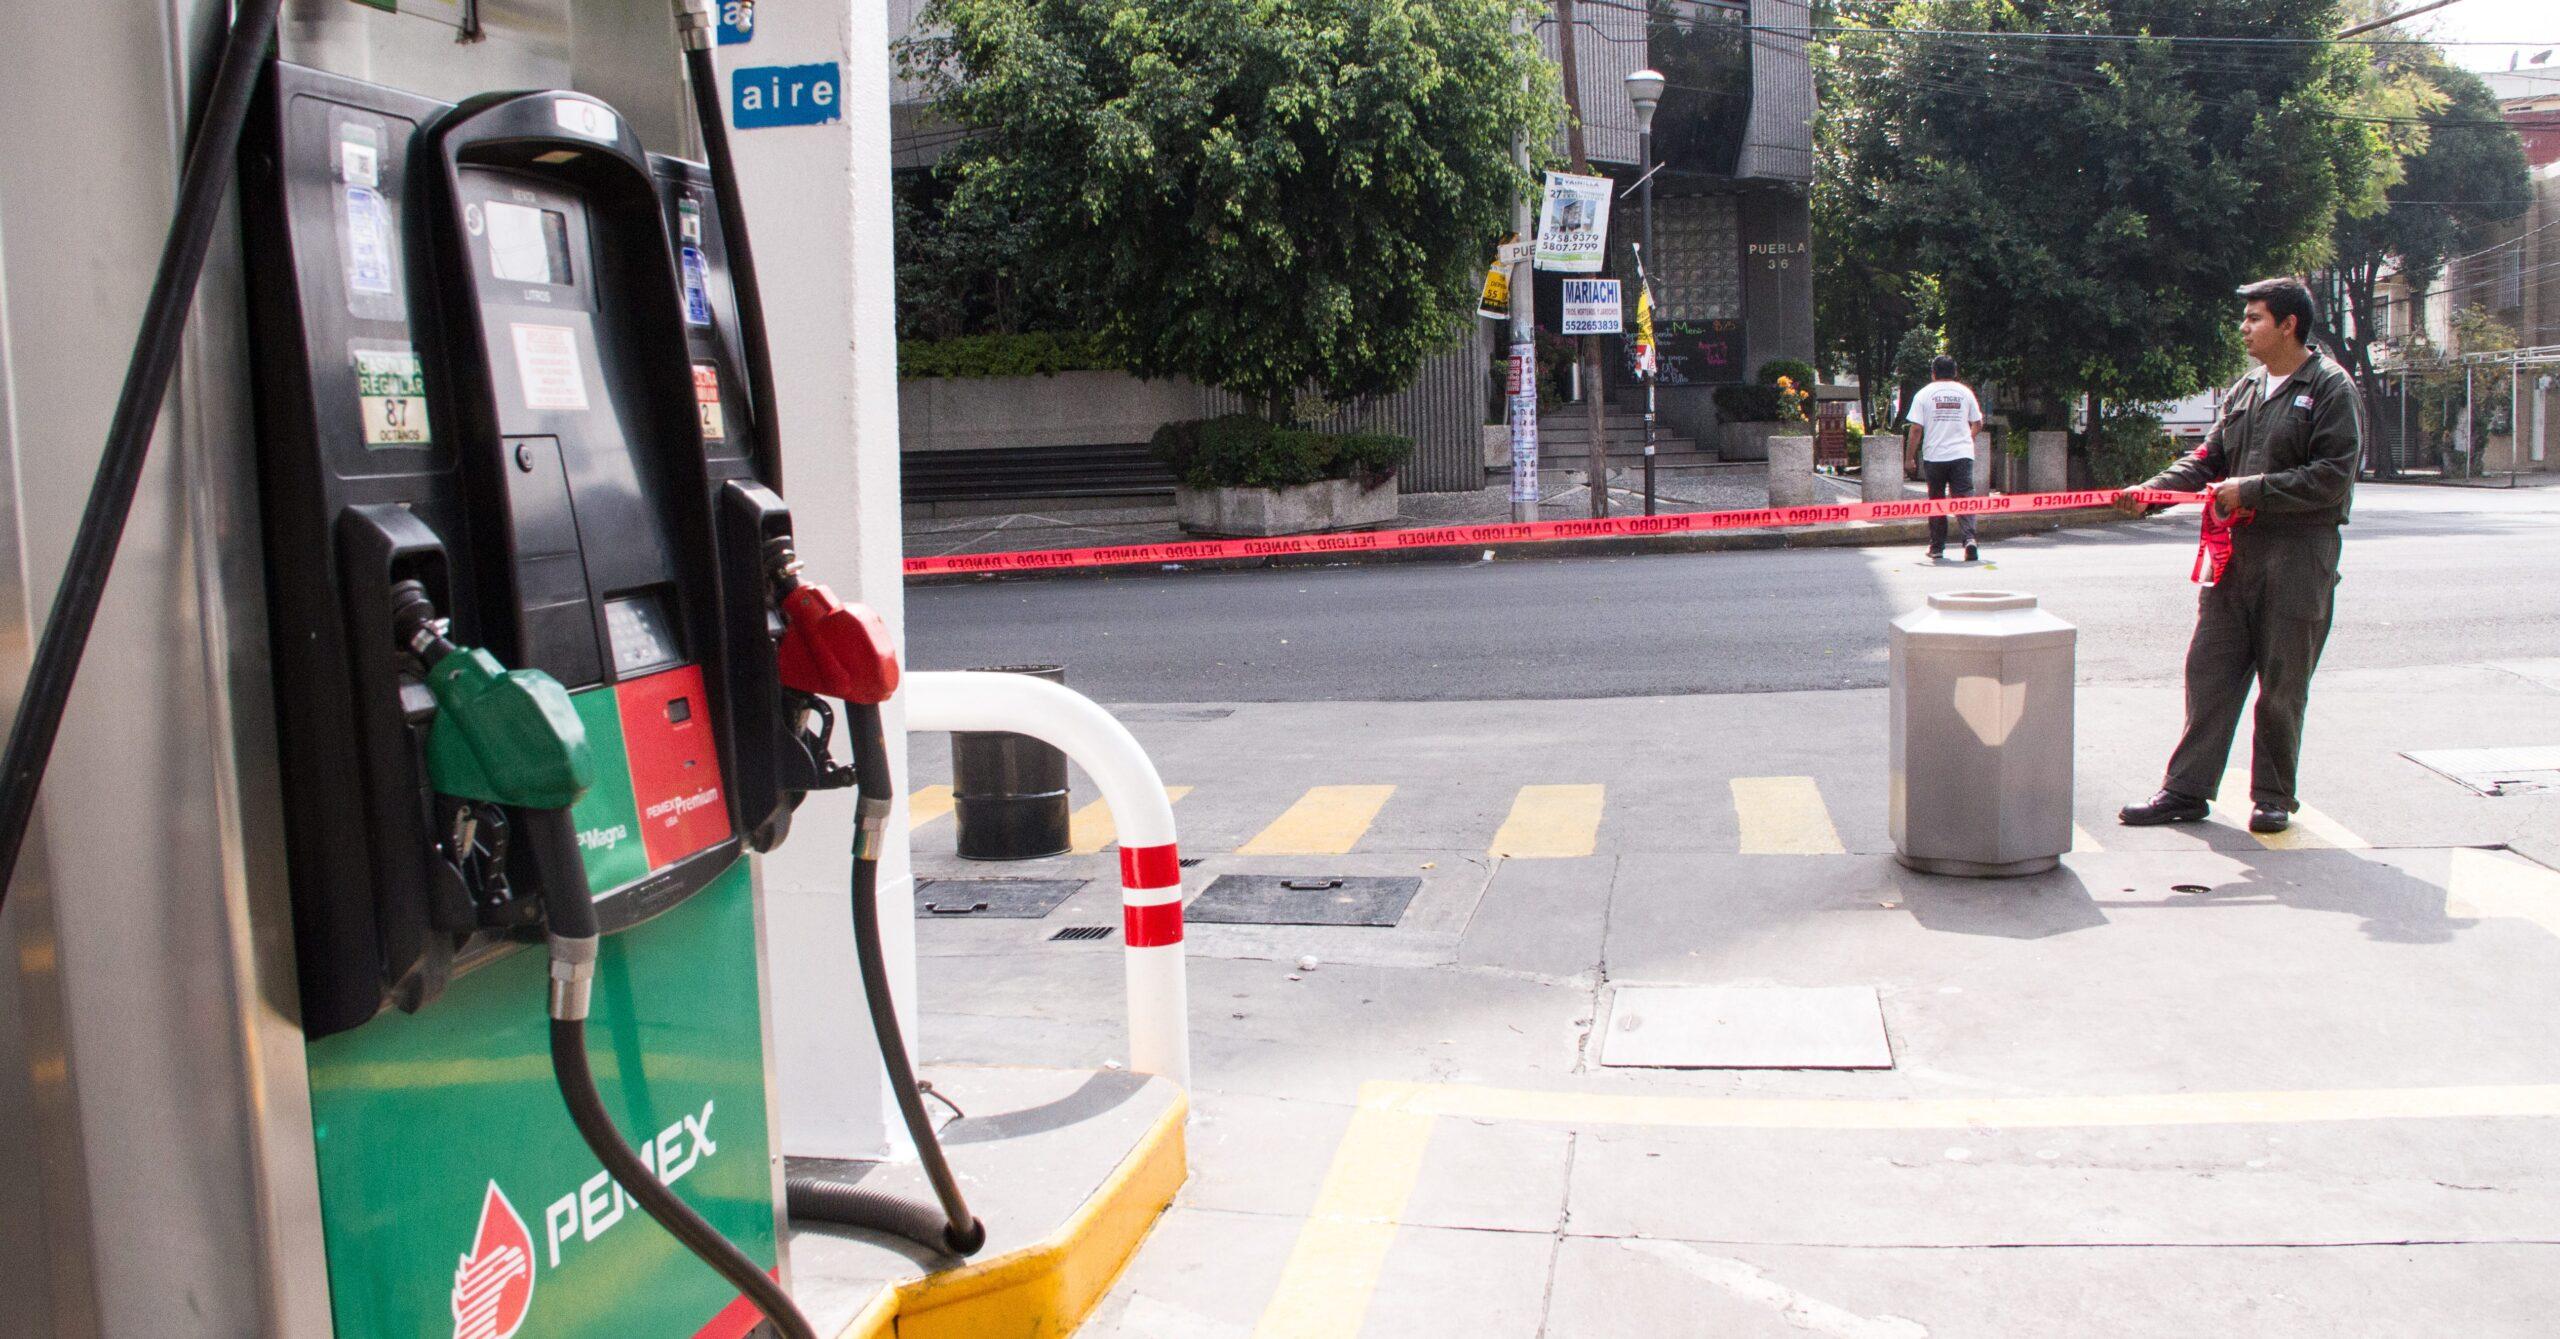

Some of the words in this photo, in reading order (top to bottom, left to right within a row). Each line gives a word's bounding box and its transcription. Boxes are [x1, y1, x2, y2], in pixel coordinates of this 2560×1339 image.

[742, 76, 834, 110] aire
[1550, 190, 1562, 199] 27
[1543, 232, 1599, 243] 5758.9379
[1513, 244, 1536, 258] PUE
[1542, 242, 1598, 252] 5807.2799
[1749, 242, 1806, 255] PUEBLA
[1565, 281, 1618, 303] MARIACHI
[1565, 320, 1619, 331] 5522653839
[360, 376, 425, 395] REGULAR
[386, 399, 408, 427] 87
[702, 403, 711, 425] 2
[380, 430, 420, 441] OCTANOS
[675, 787, 718, 816] Premium
[588, 824, 627, 850] Magna
